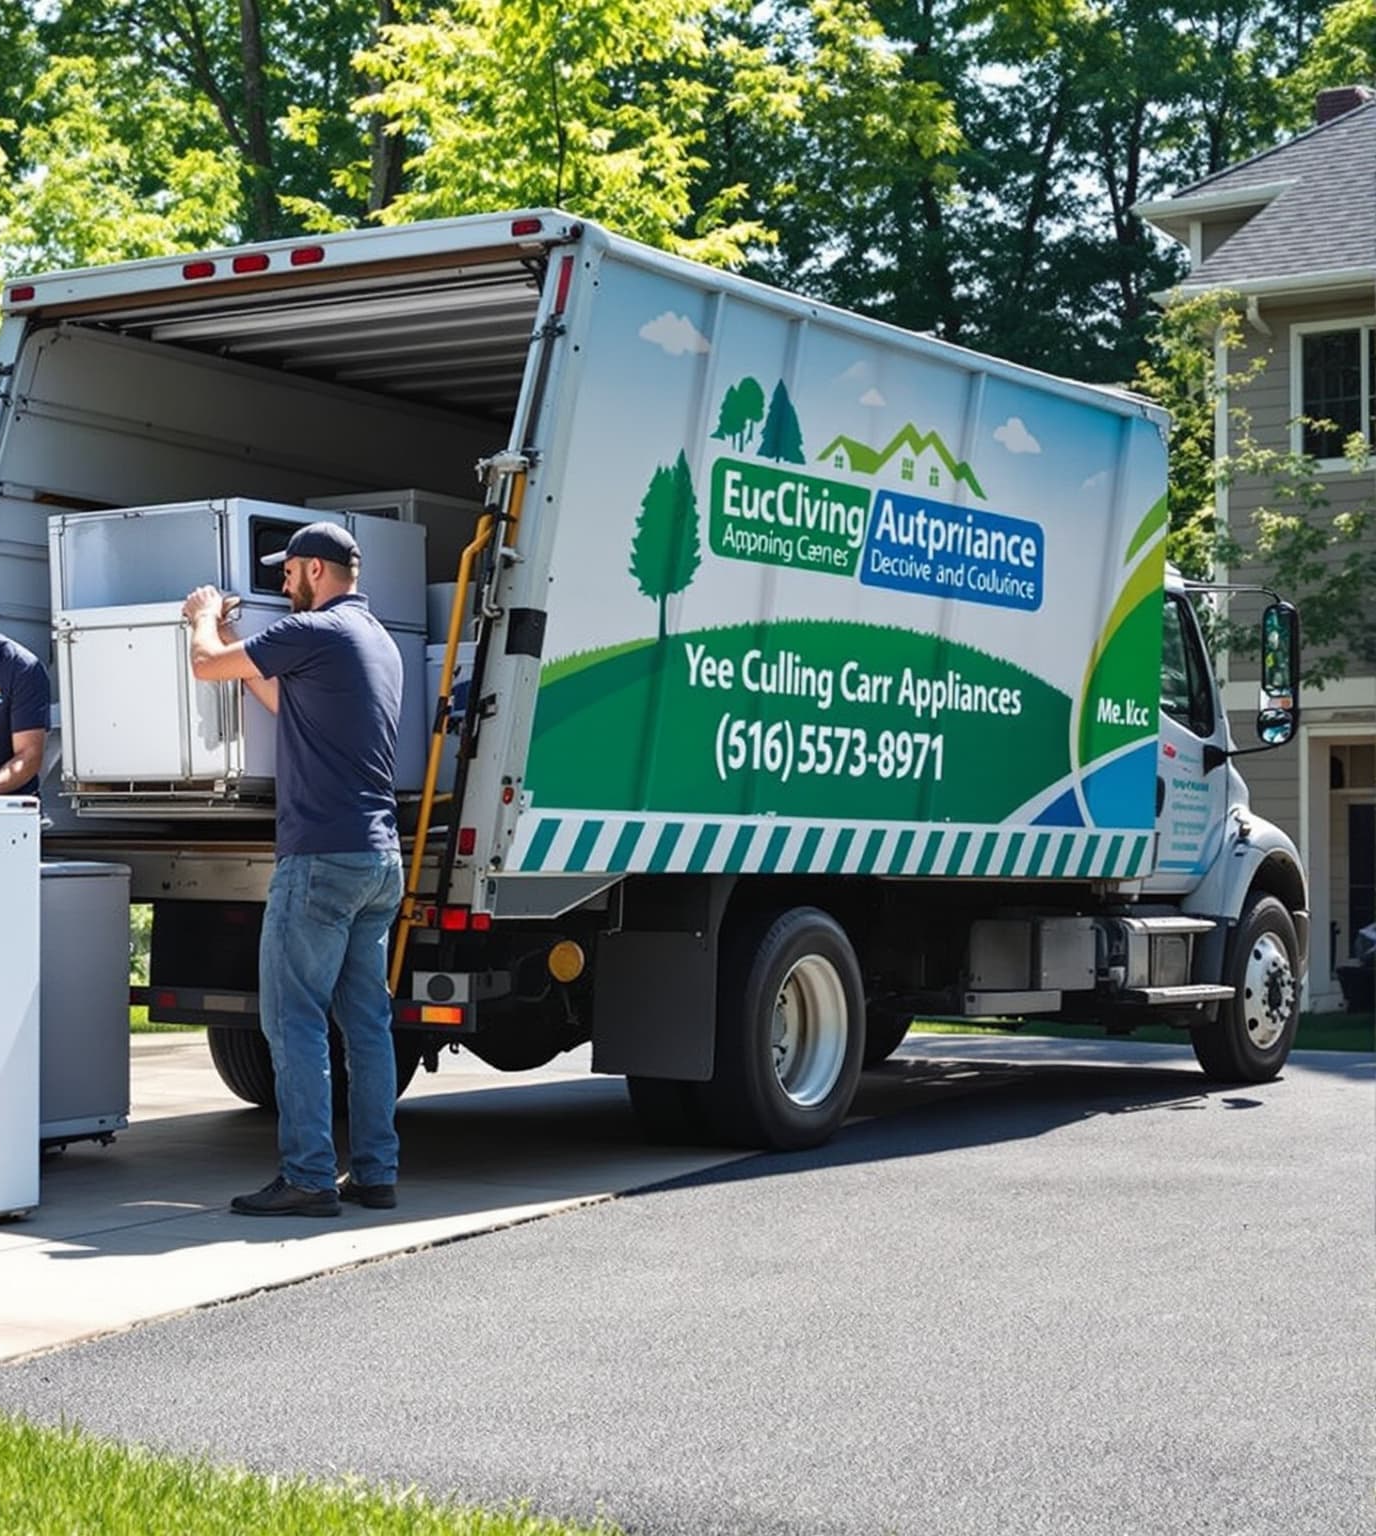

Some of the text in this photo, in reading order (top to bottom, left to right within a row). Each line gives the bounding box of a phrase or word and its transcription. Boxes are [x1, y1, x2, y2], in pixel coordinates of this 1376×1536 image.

[936, 562, 964, 587] and
[684, 642, 1022, 719] Yee Culling Carr Appliances
